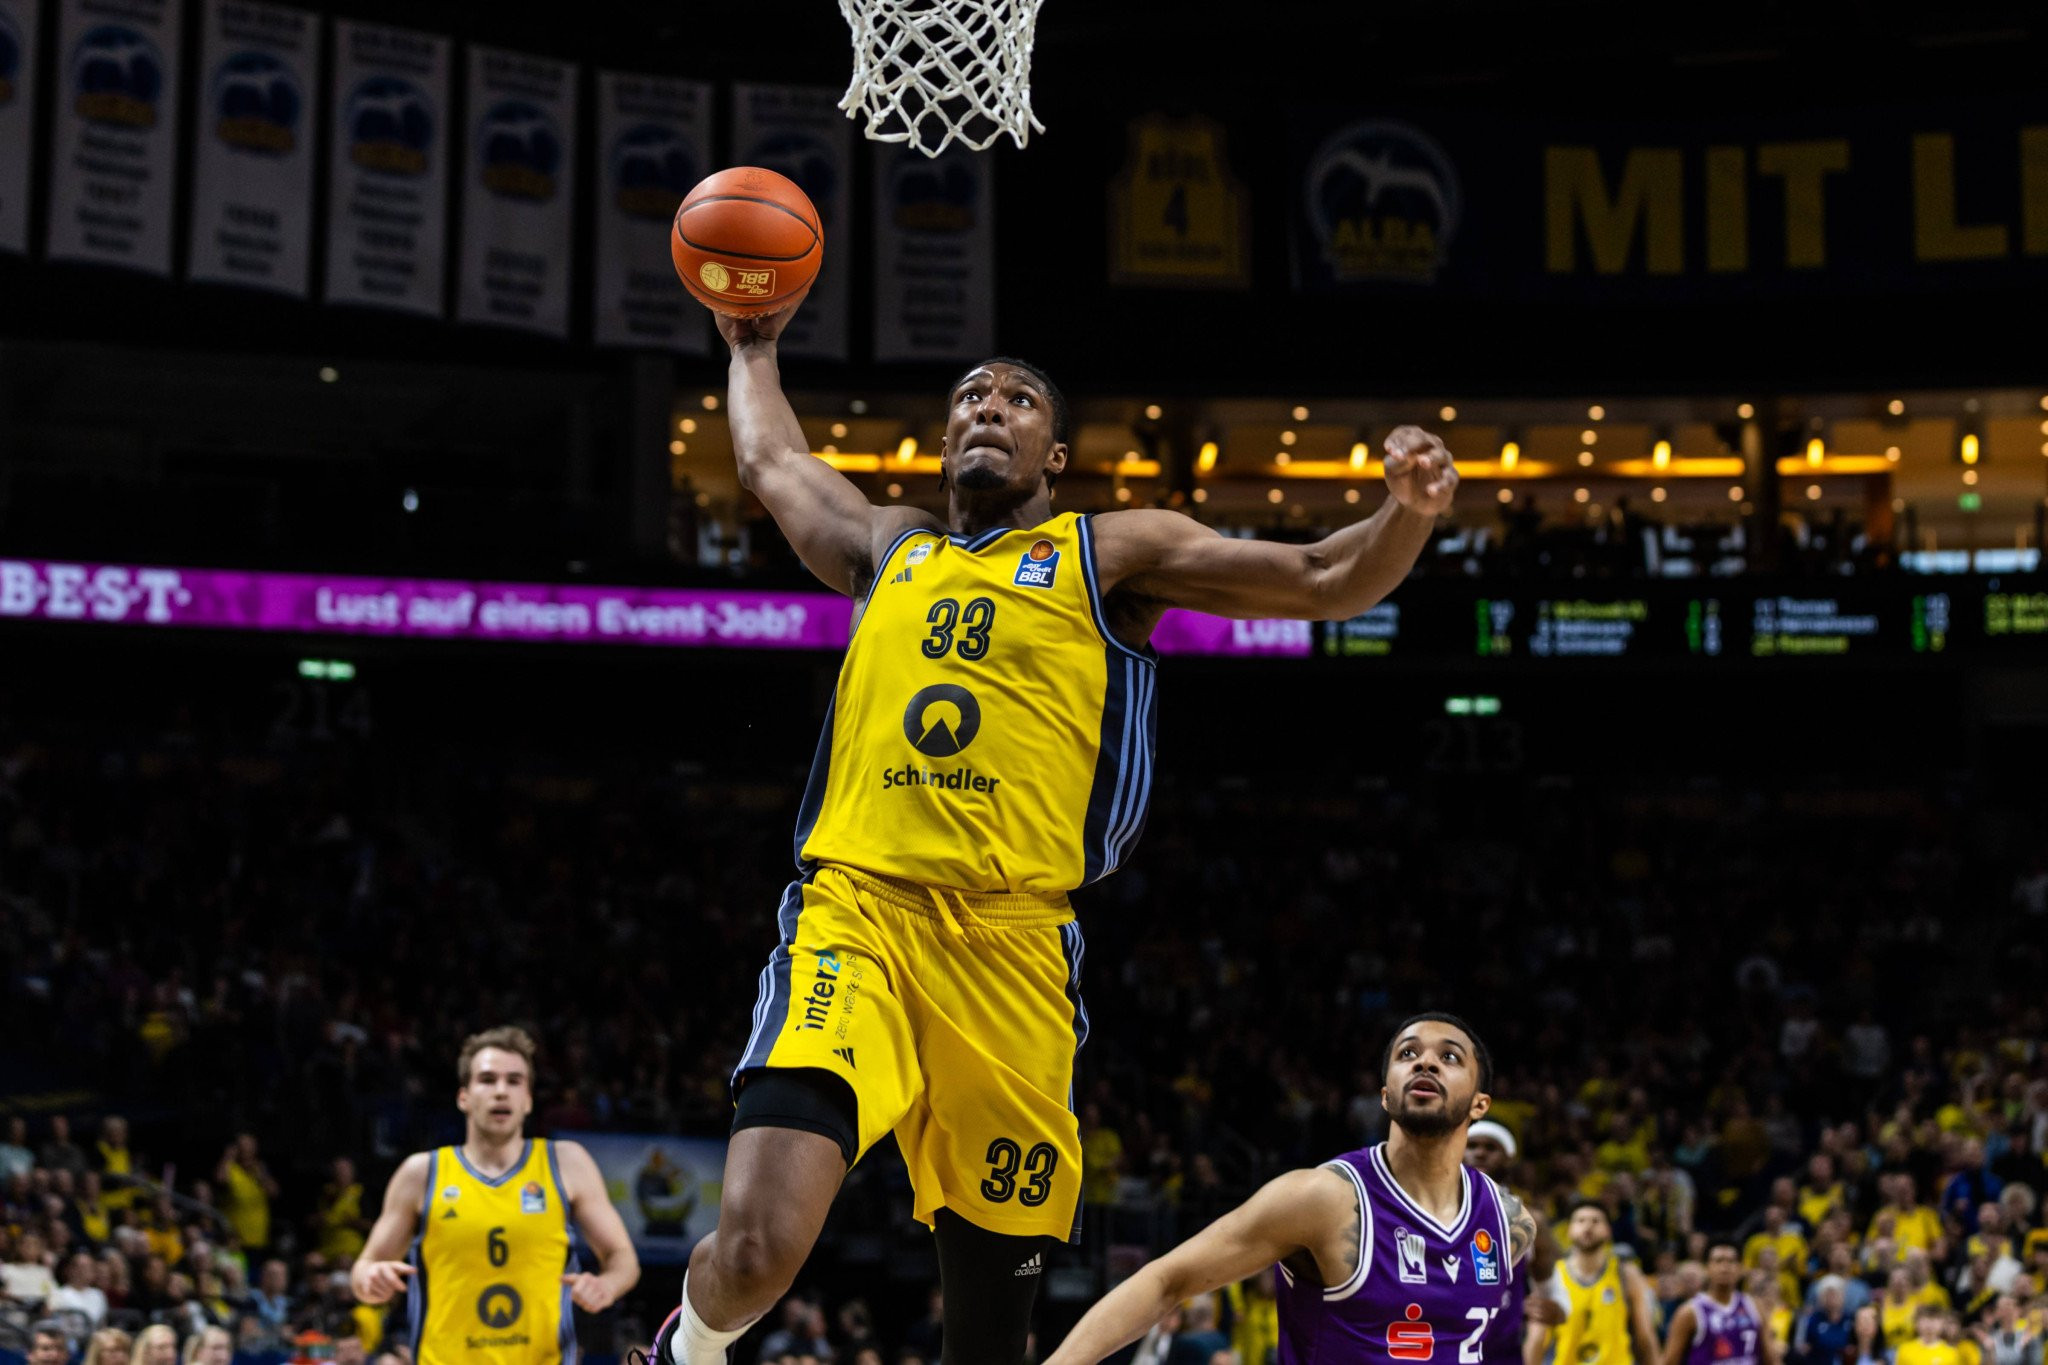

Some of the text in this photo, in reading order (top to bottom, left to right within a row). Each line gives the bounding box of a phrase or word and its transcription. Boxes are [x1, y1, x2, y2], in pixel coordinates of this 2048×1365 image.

[1543, 138, 1851, 275] MIT
[1333, 215, 1437, 250] ALBA
[737, 272, 770, 285] BBL
[1018, 571, 1049, 584] BBL
[316, 586, 400, 628] Lust
[406, 590, 476, 629] auf
[478, 593, 591, 635] einen
[921, 596, 996, 662] 33
[1418, 719, 1526, 774] 213
[883, 764, 1000, 794] Schindler
[835, 1016, 850, 1040] zero
[980, 1136, 1059, 1207] 33
[487, 1226, 508, 1267] 6
[1479, 1267, 1498, 1280] BBL
